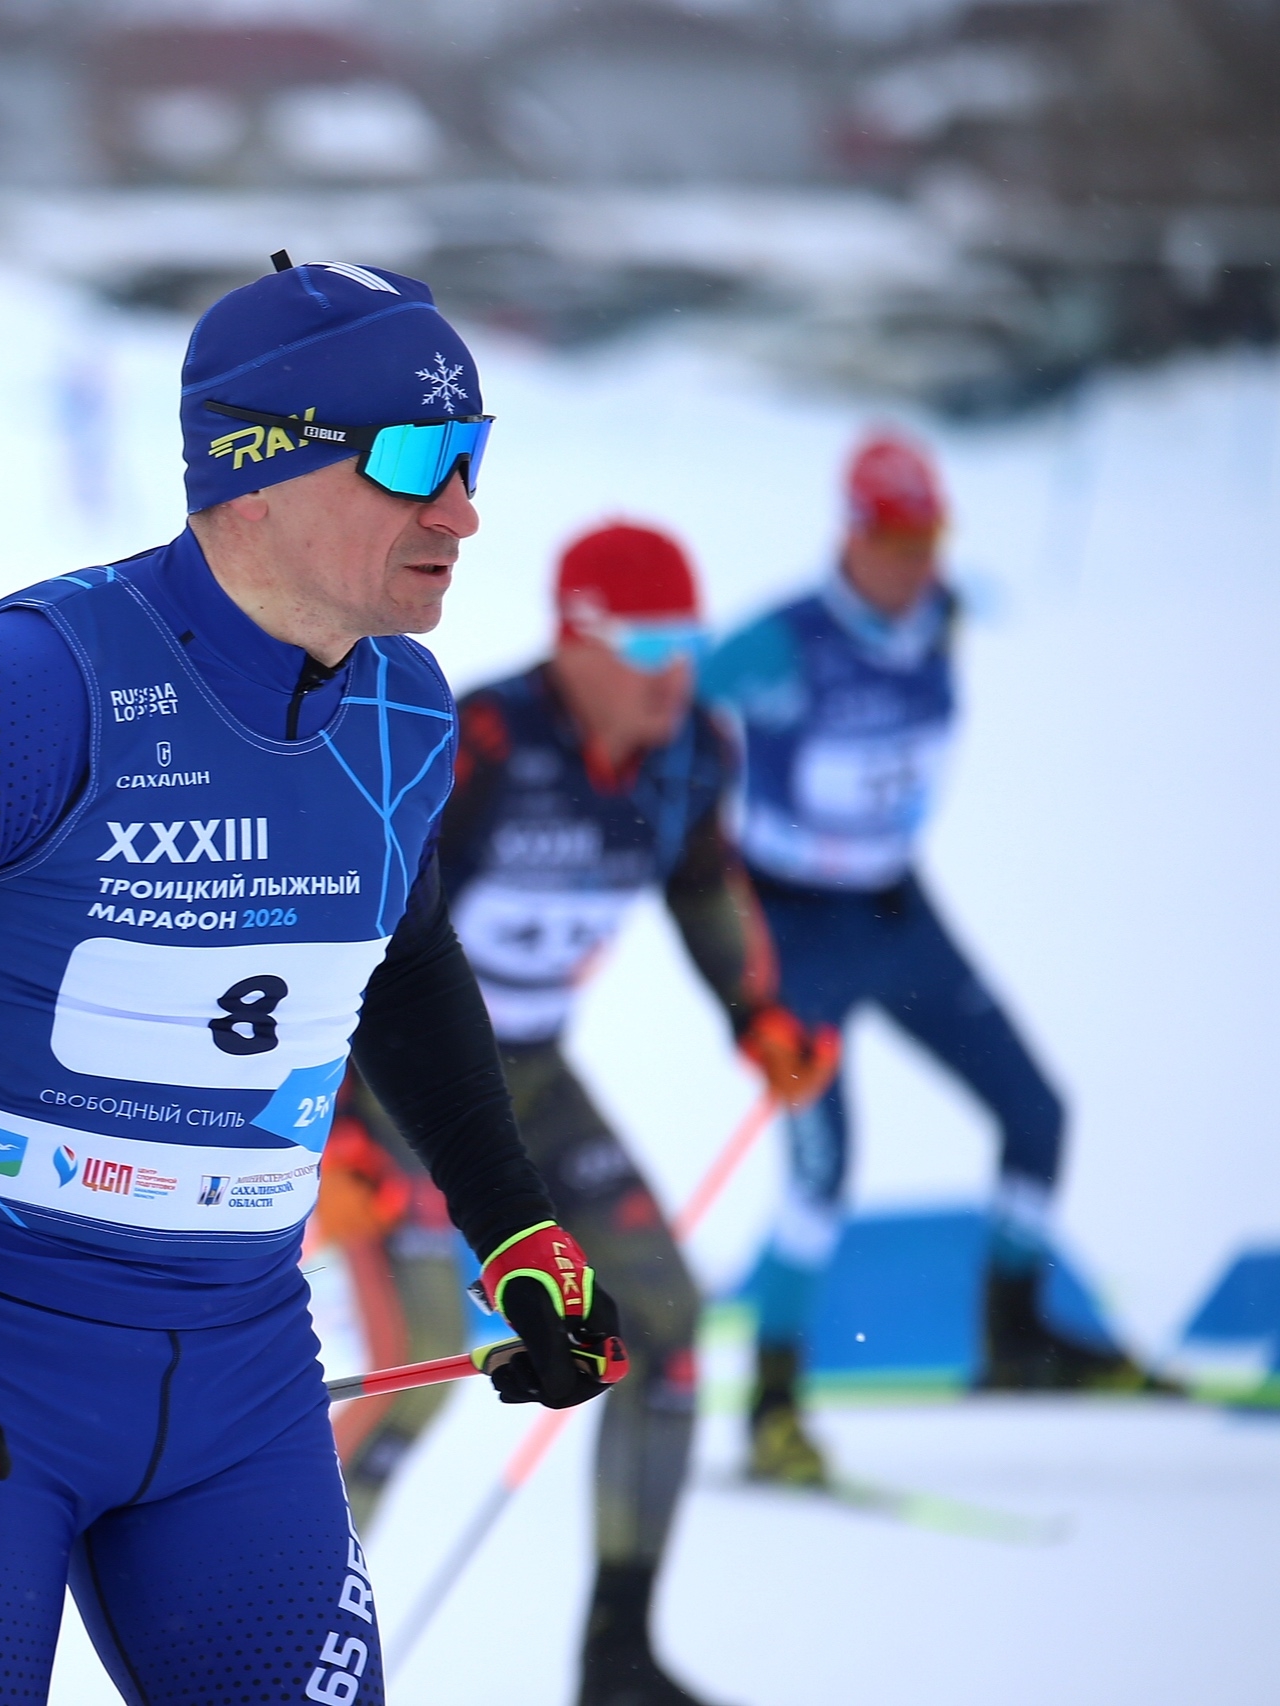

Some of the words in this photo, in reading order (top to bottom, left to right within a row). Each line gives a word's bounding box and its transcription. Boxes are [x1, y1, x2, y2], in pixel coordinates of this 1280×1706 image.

[319, 428, 346, 442] BLIZ
[110, 682, 178, 706] RUSSIA
[116, 771, 210, 788] САХАЛИН
[96, 817, 268, 863] XXXIII
[99, 873, 245, 902] ТРОИЦКИЙ
[249, 870, 360, 896] ЛЫЖНЫЙ
[87, 902, 237, 930] МАРАФОН
[241, 907, 298, 928] 2026
[208, 975, 288, 1055] 8
[39, 1089, 182, 1124] СВОБОДНЫЙ
[186, 1109, 245, 1127] СТИЛЬ
[82, 1158, 133, 1195] ЦСП
[551, 1241, 582, 1306] LEKI
[305, 1631, 368, 1706] 65
